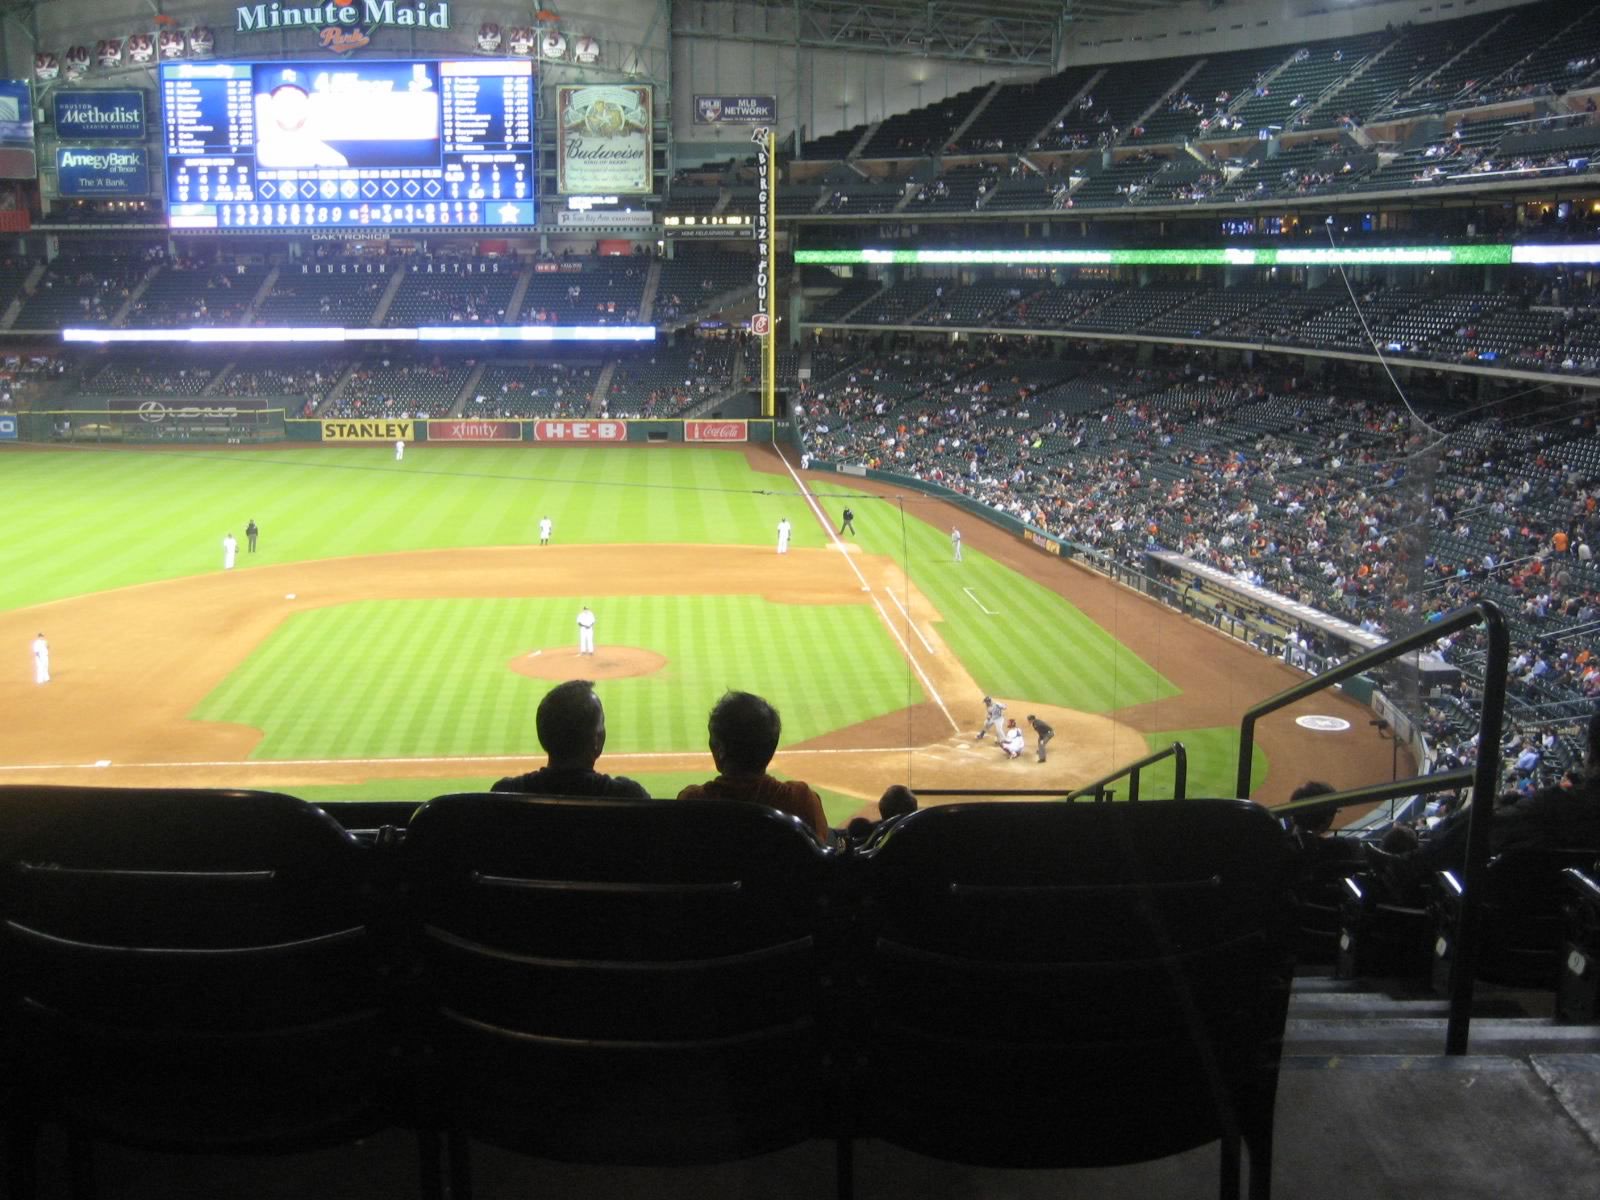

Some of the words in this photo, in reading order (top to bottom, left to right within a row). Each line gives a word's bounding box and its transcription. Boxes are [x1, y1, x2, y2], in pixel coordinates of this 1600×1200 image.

[237, 2, 356, 31] Minute
[365, 0, 449, 28] Maid
[319, 27, 370, 48] Park
[549, 31, 560, 46] 5
[738, 99, 756, 107] MLB
[62, 107, 140, 123] Methodist
[725, 107, 768, 115] NETWORK
[566, 138, 644, 160] Budweiser
[62, 152, 140, 169] AmegyBank
[80, 178, 94, 186] The
[758, 152, 769, 239] BURGERZ
[332, 207, 341, 222] 9
[311, 233, 390, 241] DAKTRONICS
[302, 264, 386, 273] HOUSTON
[427, 264, 499, 273] ASTROS
[757, 260, 767, 312] FOUL
[325, 424, 409, 437] STANLEY
[452, 423, 497, 439] xfinity
[546, 424, 616, 438] H-E-B
